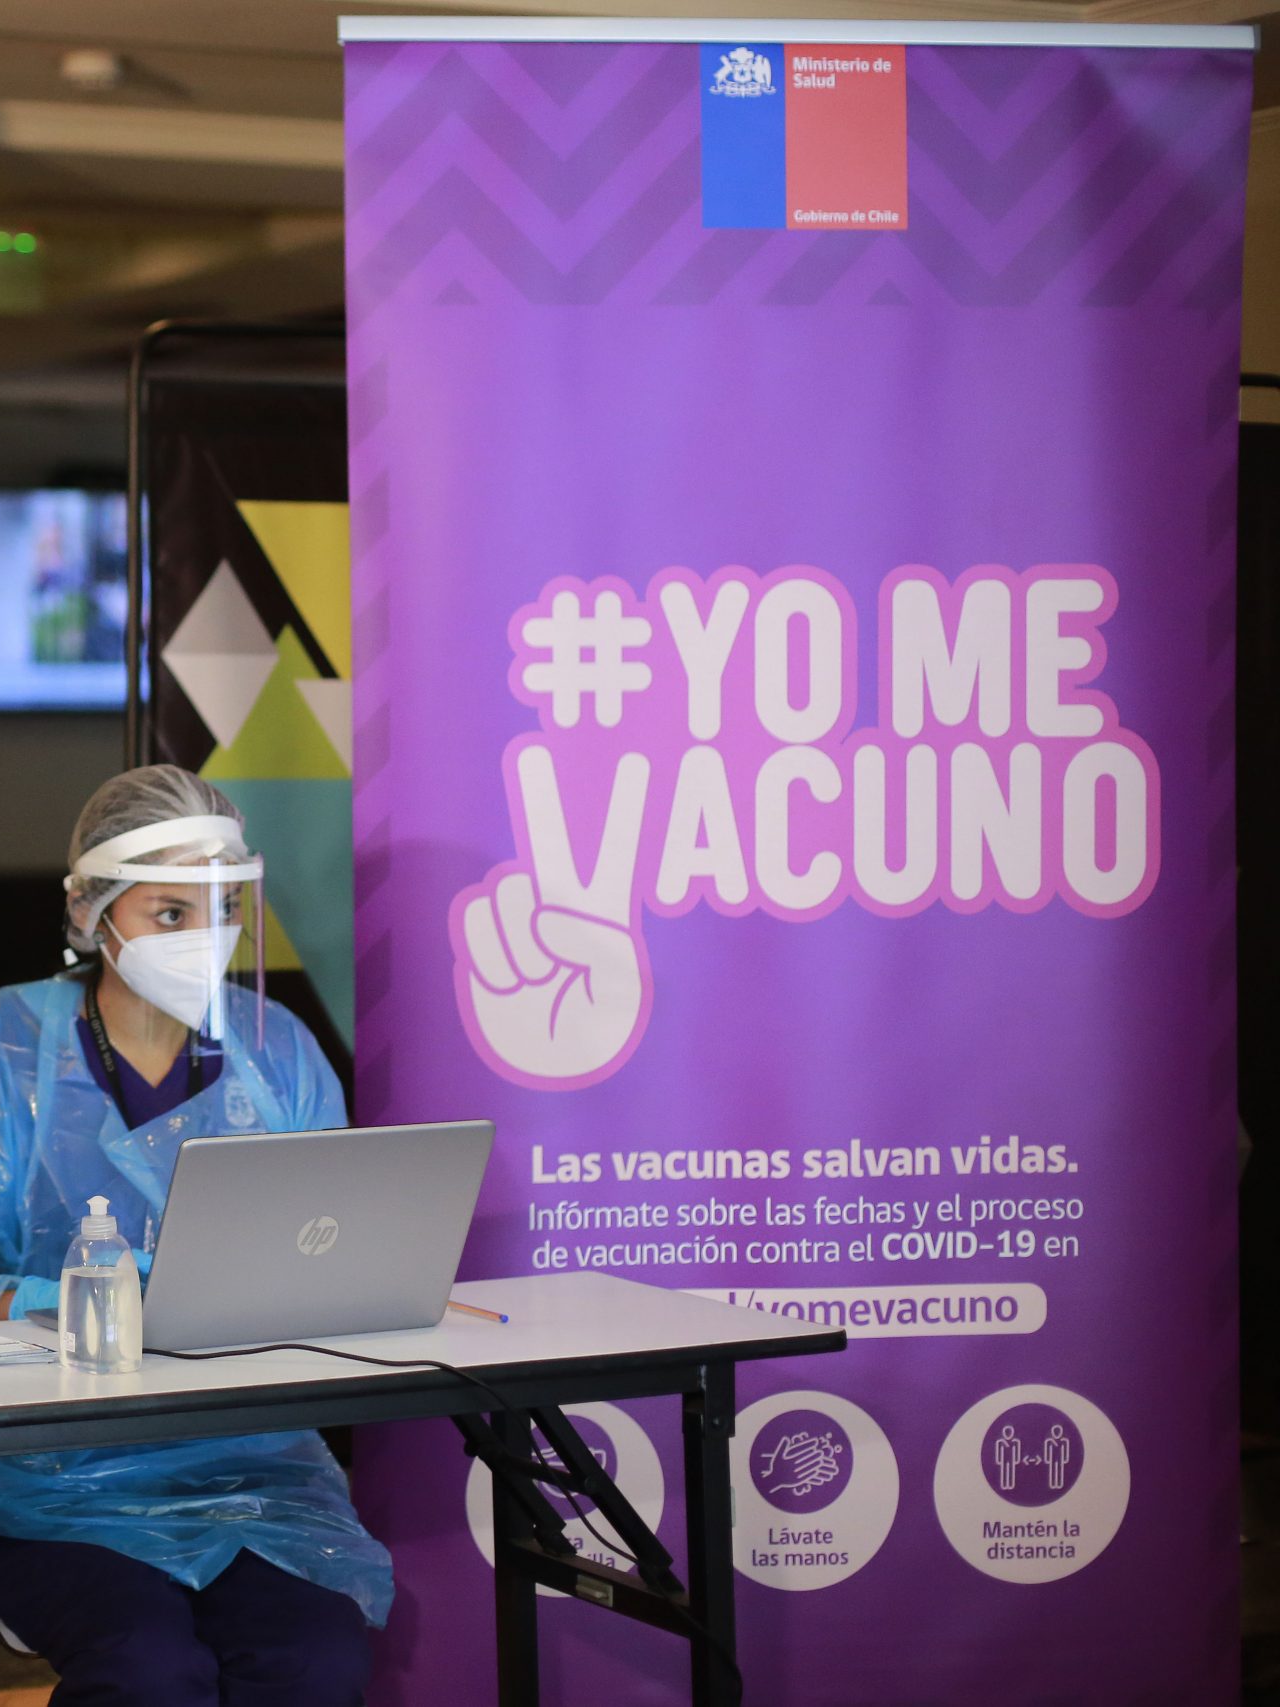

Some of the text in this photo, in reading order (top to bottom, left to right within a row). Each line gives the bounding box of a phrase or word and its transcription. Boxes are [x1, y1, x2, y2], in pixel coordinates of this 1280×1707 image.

[793, 57, 891, 72] Ministerio de
[793, 73, 836, 89] Salud
[794, 209, 899, 222] Gobierno de Chile
[522, 579, 1104, 744] #YO ME
[517, 742, 1147, 926] VACUNO
[532, 1135, 1078, 1184] Las vacunas salvan vidas.
[530, 1193, 1084, 1231] Infórmate sobre las fechas y el proceso
[298, 1216, 338, 1255] hp
[532, 1230, 1079, 1269] de vacunación contra el COVID-19 en
[729, 1290, 1019, 1326] omevacuno
[769, 1527, 833, 1546] Lávate
[983, 1520, 1081, 1539] Mantén la
[752, 1549, 849, 1567] las manos
[986, 1541, 1076, 1560] distancia
